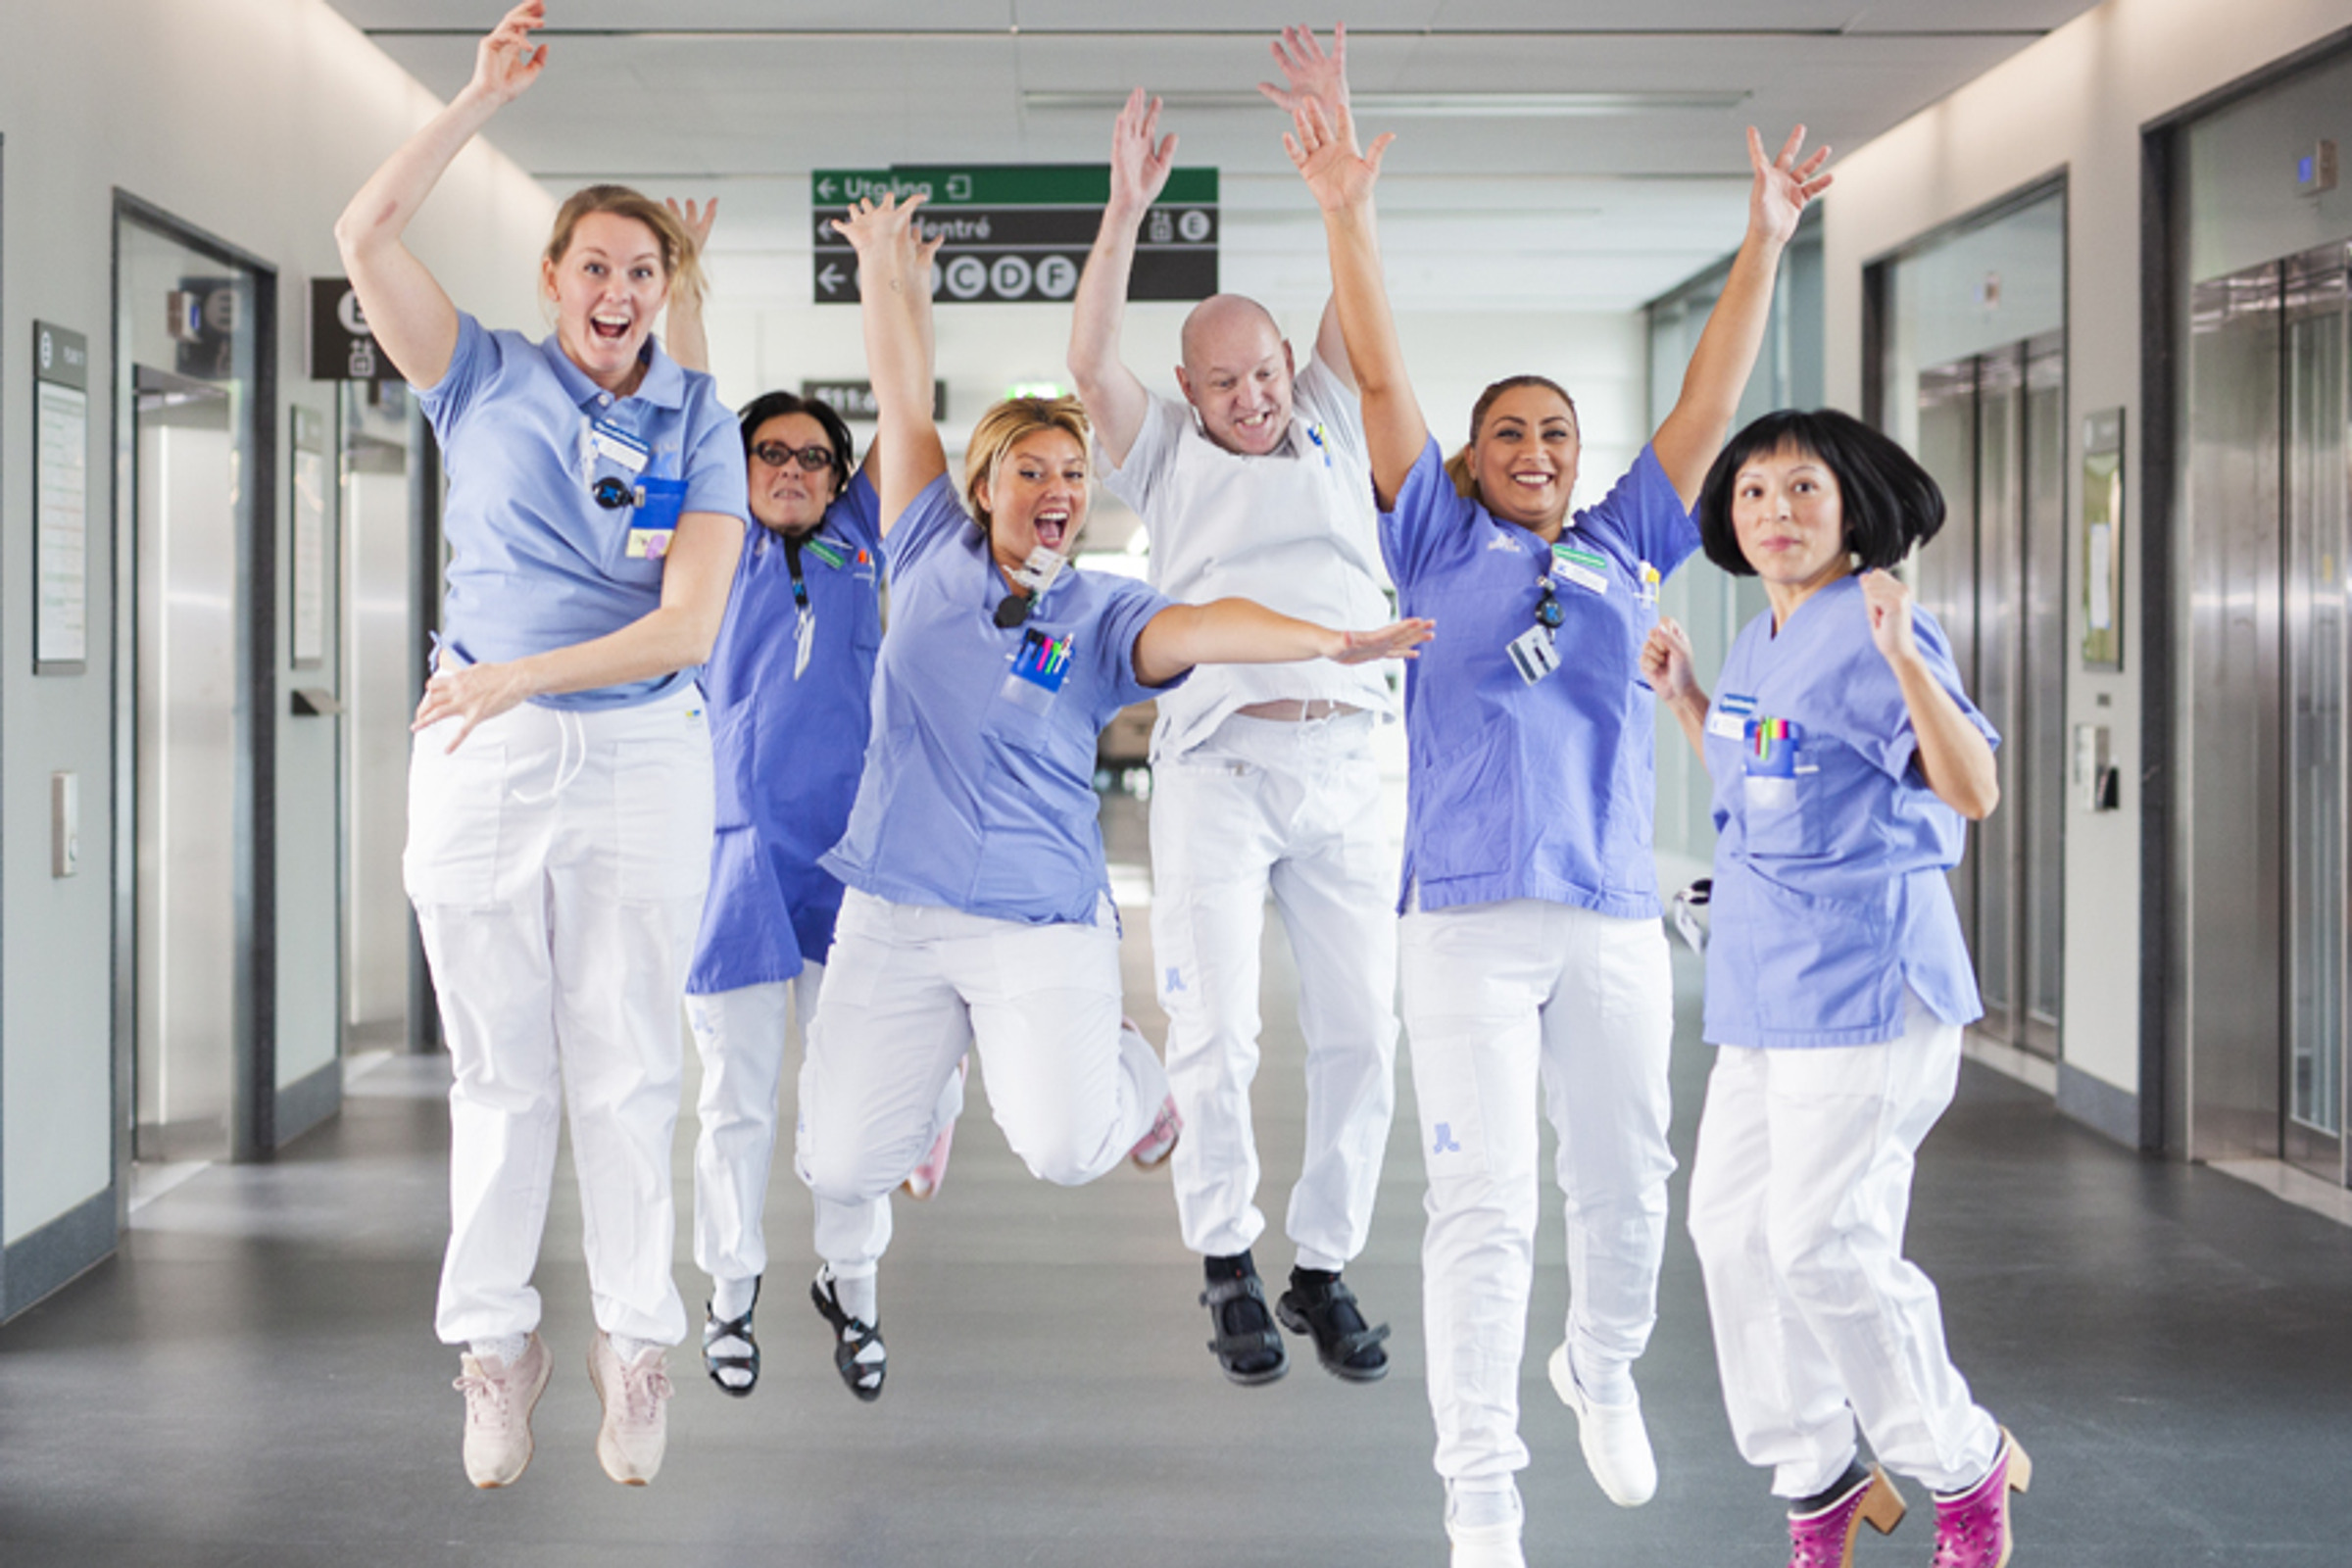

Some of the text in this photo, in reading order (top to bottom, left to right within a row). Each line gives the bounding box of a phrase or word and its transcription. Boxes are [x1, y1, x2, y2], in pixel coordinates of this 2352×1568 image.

[954, 263, 1066, 290] C D F
